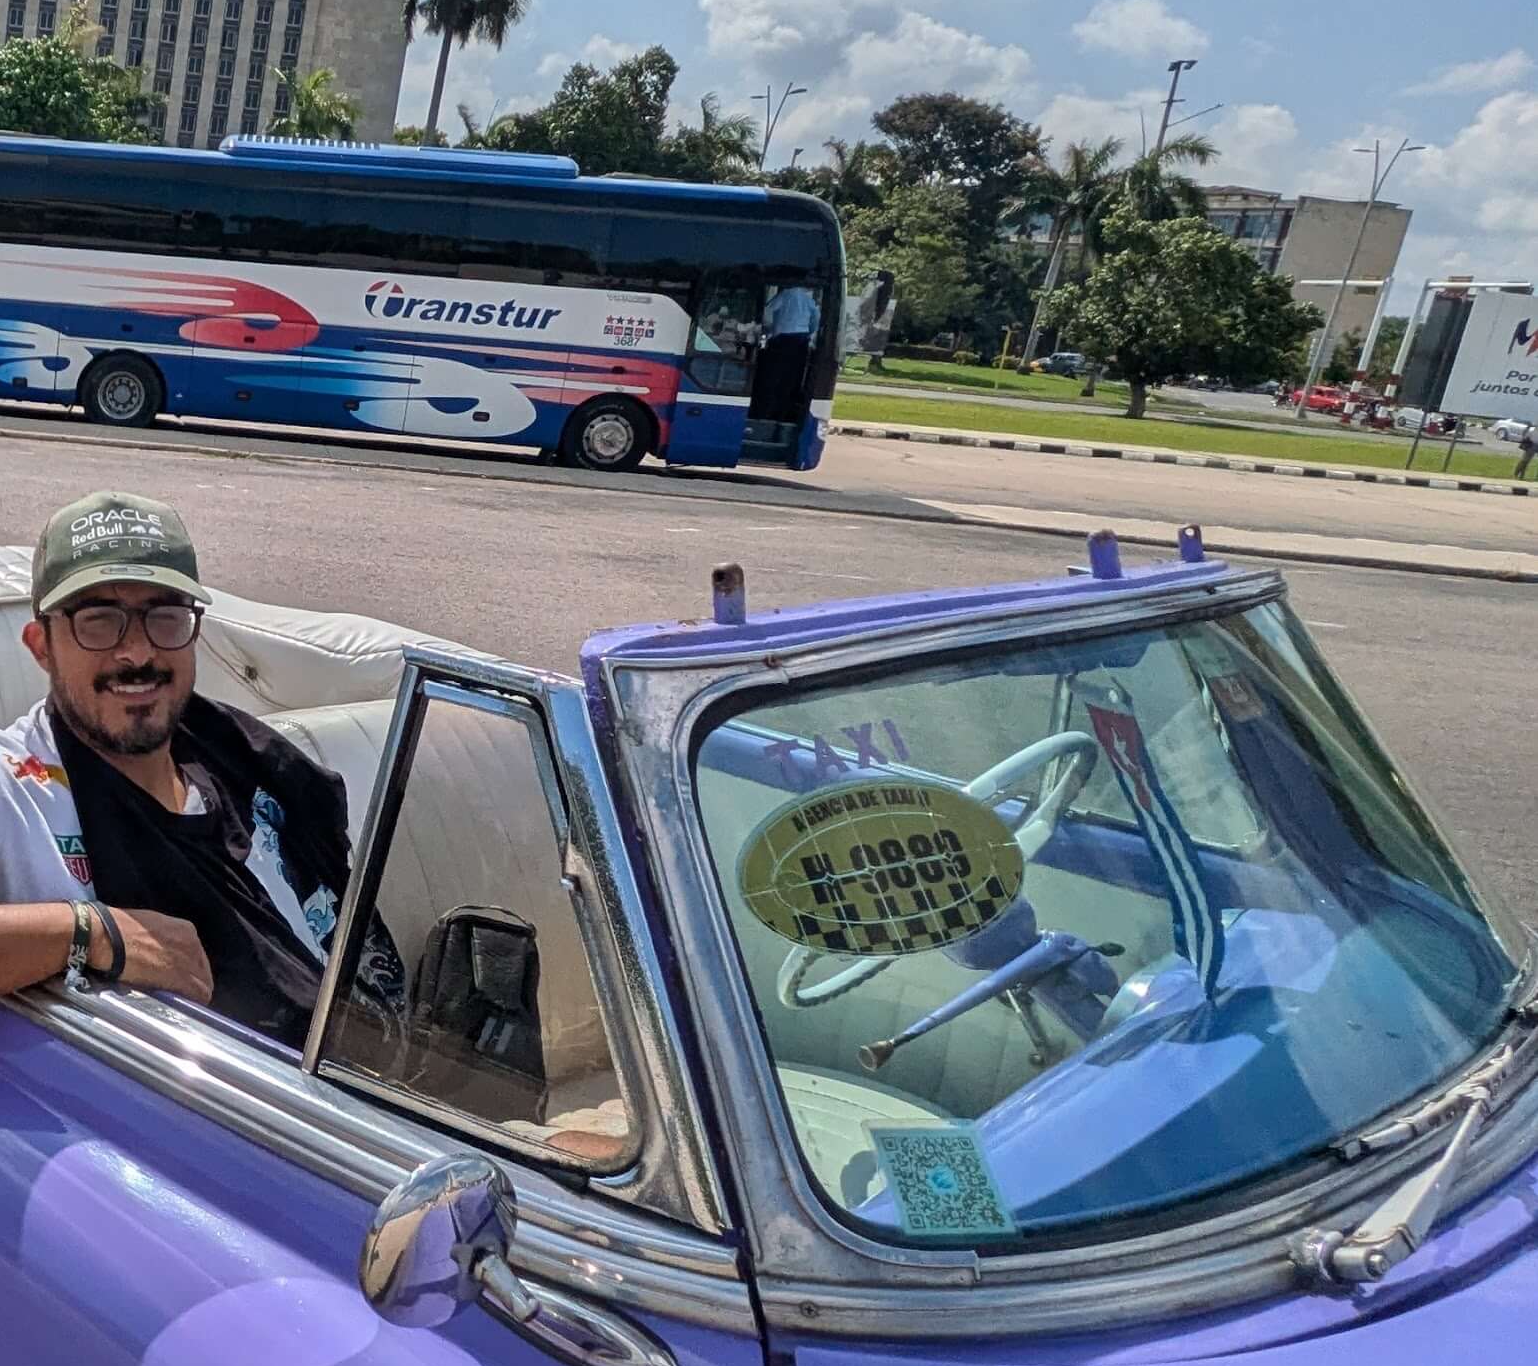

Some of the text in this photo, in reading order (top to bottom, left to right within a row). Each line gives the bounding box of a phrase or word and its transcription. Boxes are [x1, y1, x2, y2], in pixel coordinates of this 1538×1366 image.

[614, 335, 641, 347] 3687
[1470, 379, 1530, 396] juntos
[71, 509, 163, 532] ORACLE
[72, 522, 123, 546] Red Bull
[73, 540, 170, 560] RACING
[764, 719, 911, 782] TAXI
[856, 789, 880, 809] DE
[56, 837, 87, 854] TA
